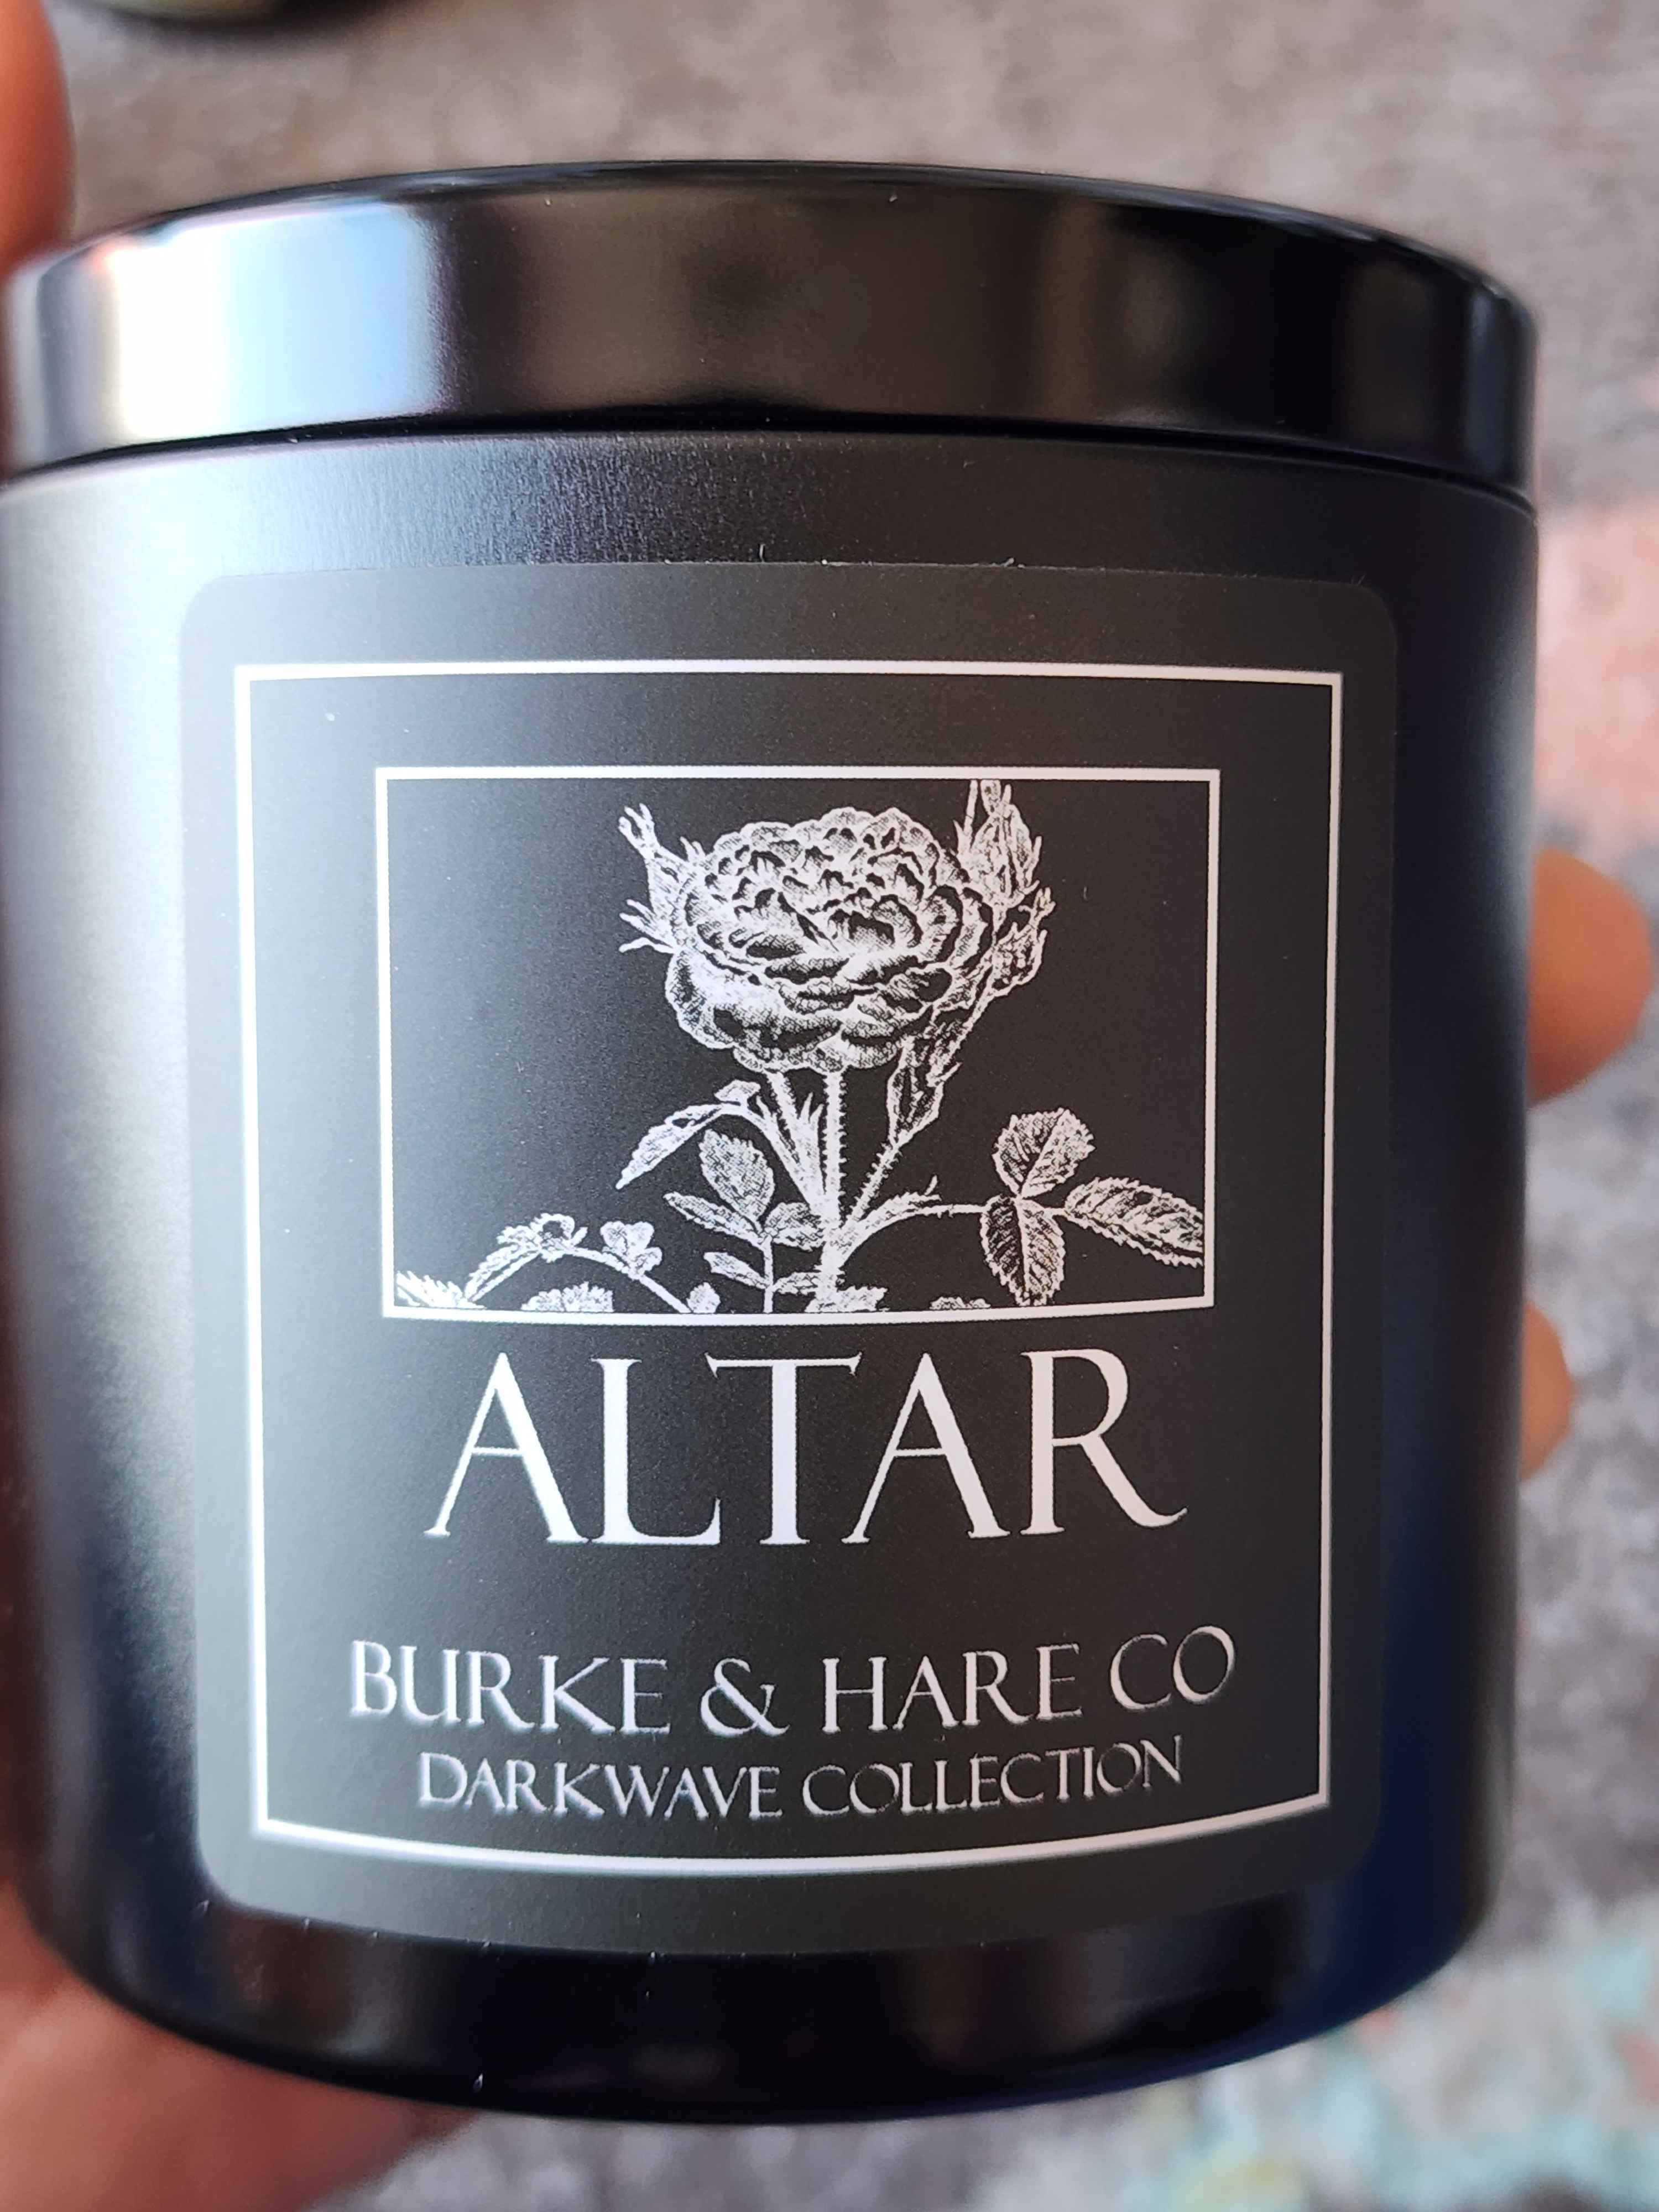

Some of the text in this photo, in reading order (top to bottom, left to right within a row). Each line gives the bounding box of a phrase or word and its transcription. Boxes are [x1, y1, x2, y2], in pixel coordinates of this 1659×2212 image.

[425, 1349, 1187, 1545] ALTAR
[351, 1625, 1235, 1737] BURKE & HARE CO
[419, 1735, 1182, 1820] DARKWAVE COLLECTION
